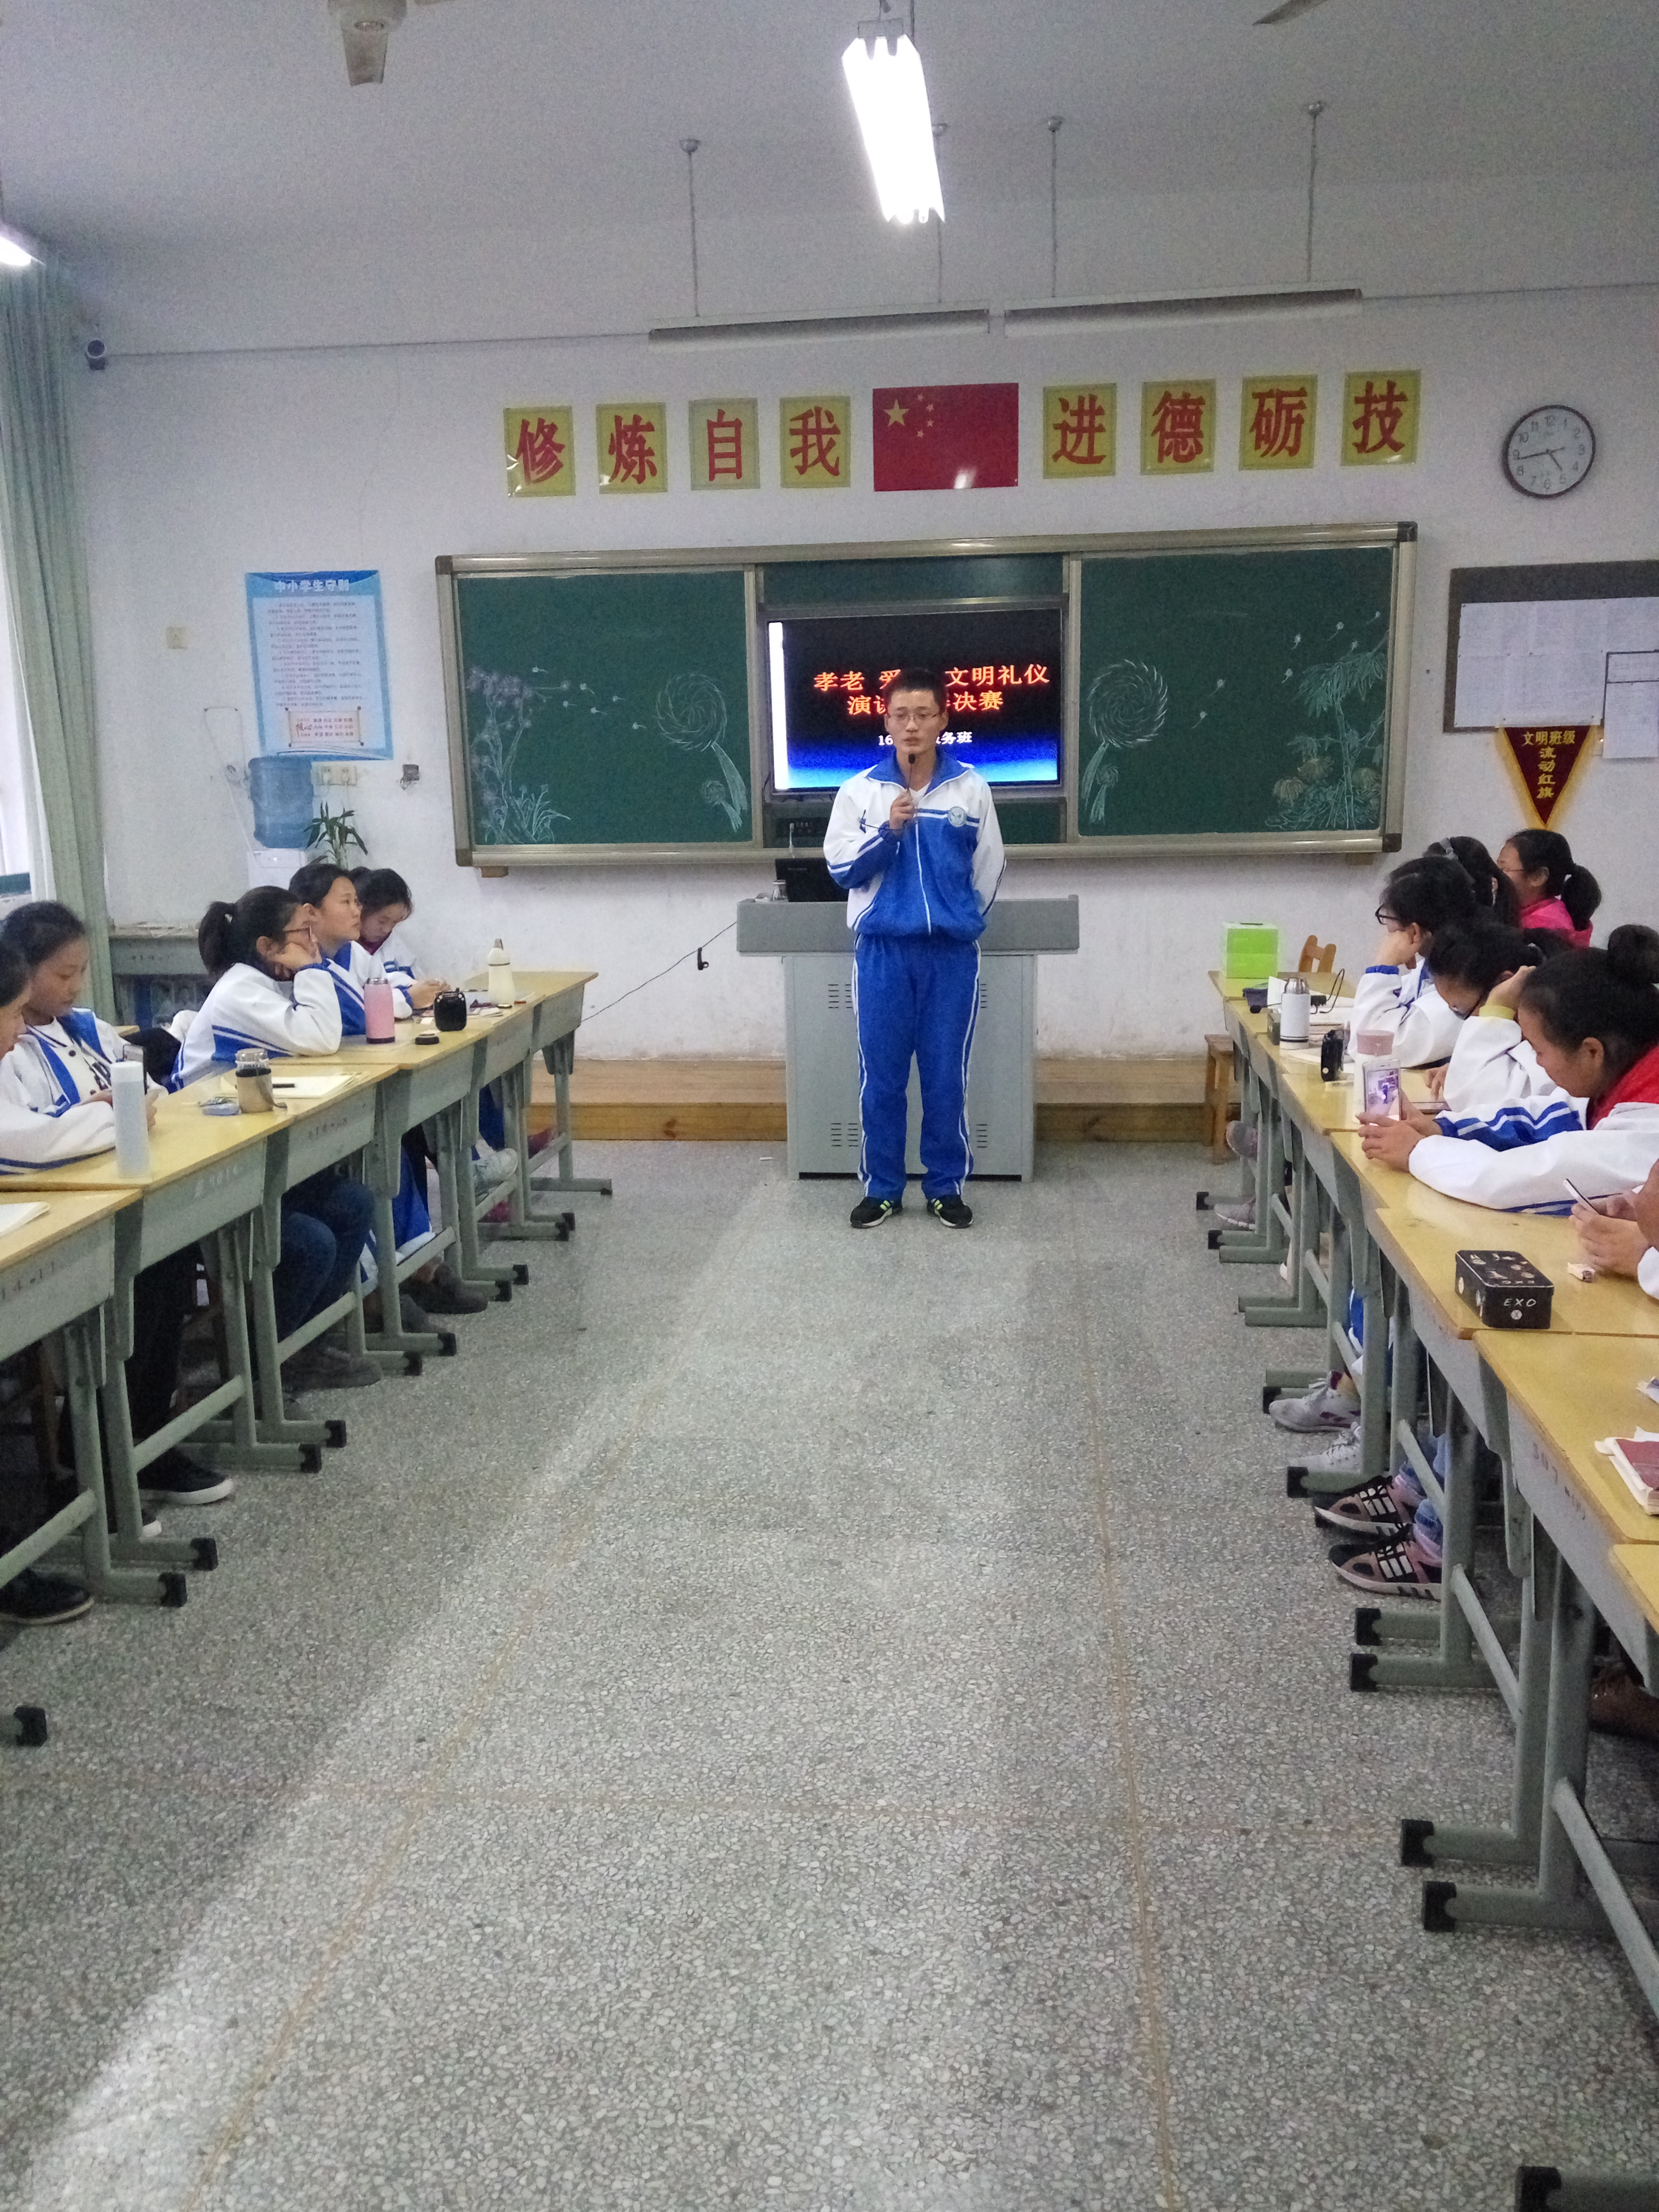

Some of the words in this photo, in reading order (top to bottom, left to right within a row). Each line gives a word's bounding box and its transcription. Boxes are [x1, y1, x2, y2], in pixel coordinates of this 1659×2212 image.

[515, 406, 841, 485] 修炼自我
[1052, 380, 1408, 465] 进德砺技
[814, 671, 865, 692] 孝老
[945, 664, 1050, 686] 文明礼仪
[1522, 730, 1576, 747] 文明班级
[1537, 747, 1556, 799] 流动红旗
[1503, 1298, 1537, 1307] EXO
